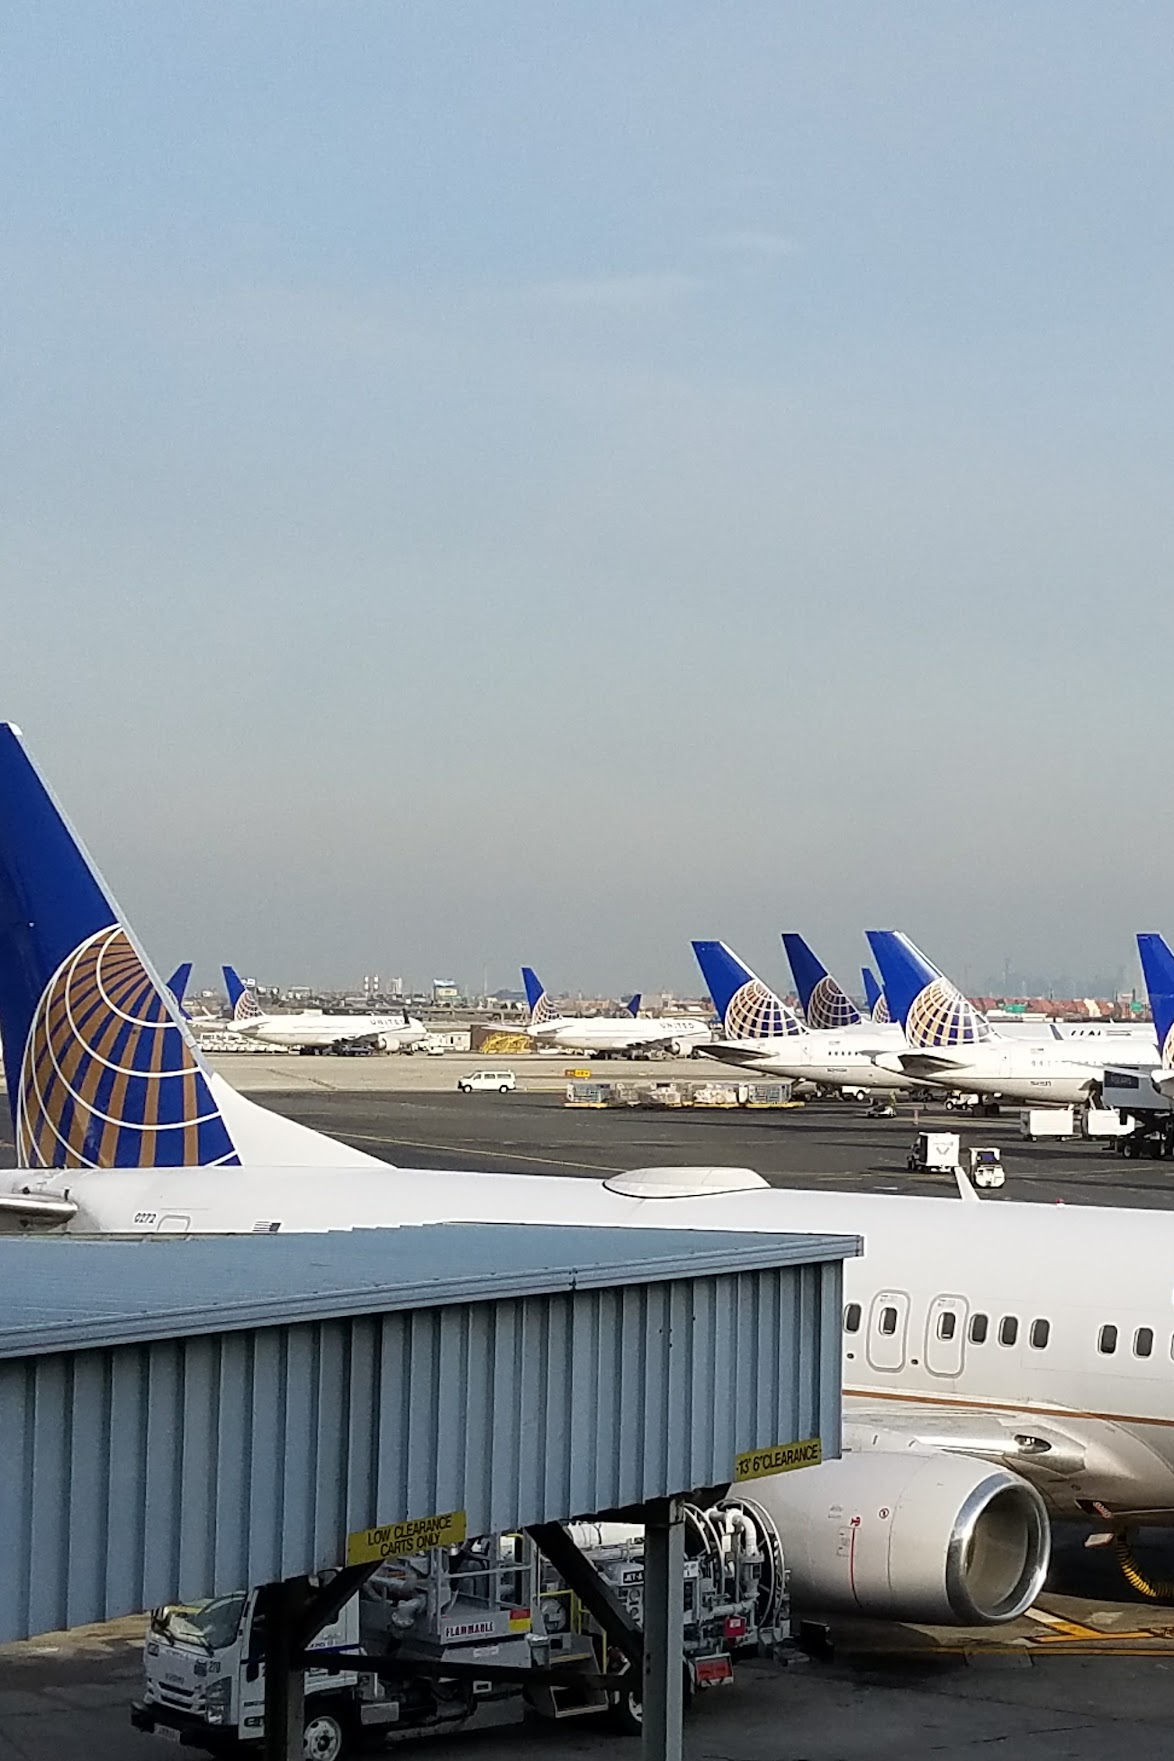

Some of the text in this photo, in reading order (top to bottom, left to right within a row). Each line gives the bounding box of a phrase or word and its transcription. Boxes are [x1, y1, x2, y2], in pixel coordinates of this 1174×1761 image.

[134, 1212, 157, 1224] 0272
[763, 1443, 819, 1470] CLEARANCE
[367, 1515, 453, 1546] LOW CLEARANCE
[380, 1531, 441, 1557] CARTS ONLY
[446, 1621, 494, 1637] FLAMMABLE
